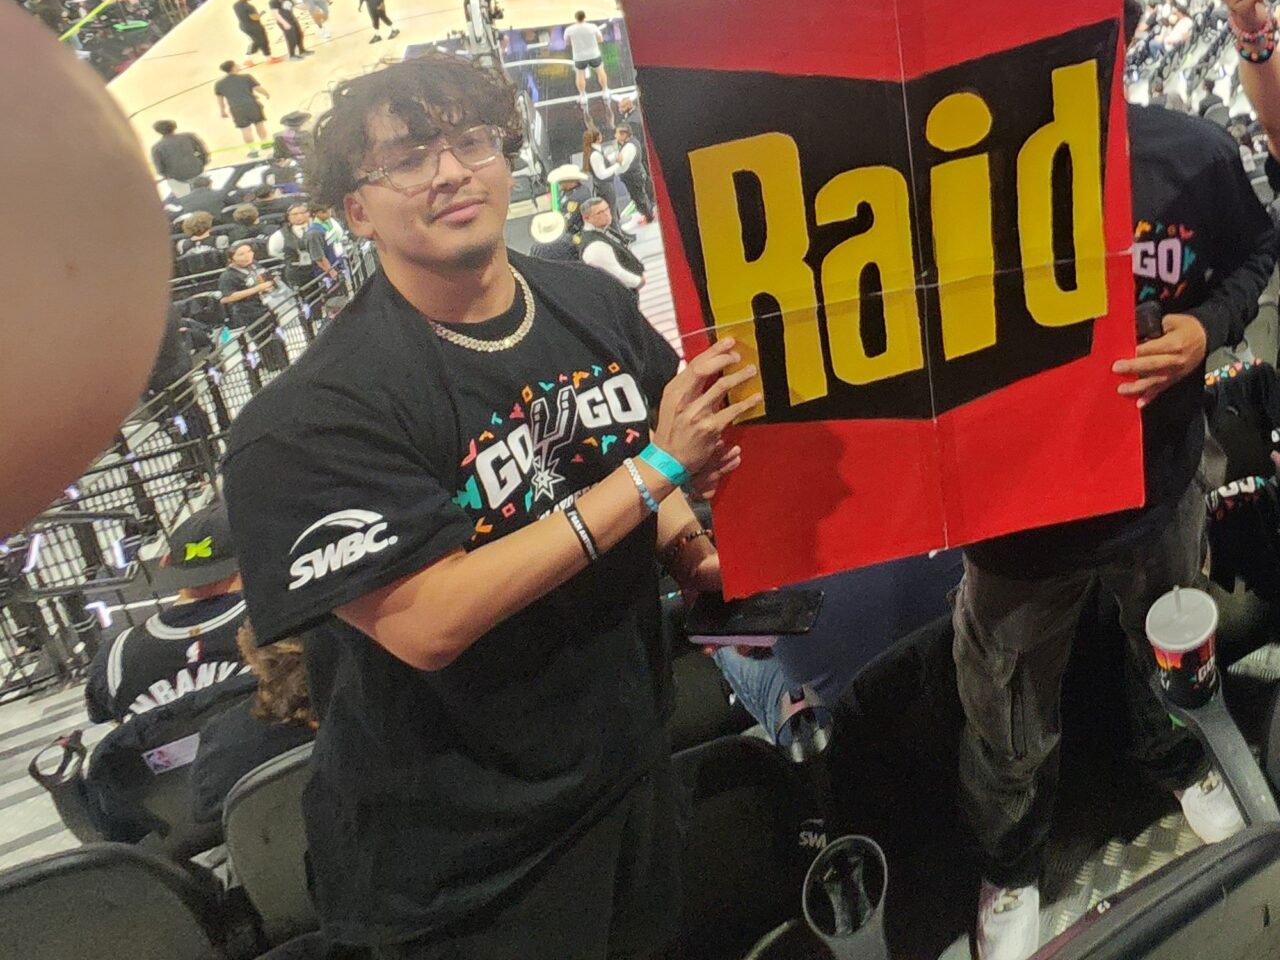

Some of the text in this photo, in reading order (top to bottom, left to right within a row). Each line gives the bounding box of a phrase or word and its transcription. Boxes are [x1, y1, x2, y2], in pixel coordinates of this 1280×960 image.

[688, 58, 1108, 426] Raid
[1132, 238, 1182, 285] GO
[577, 373, 647, 430] GO
[289, 521, 389, 591] SWBC
